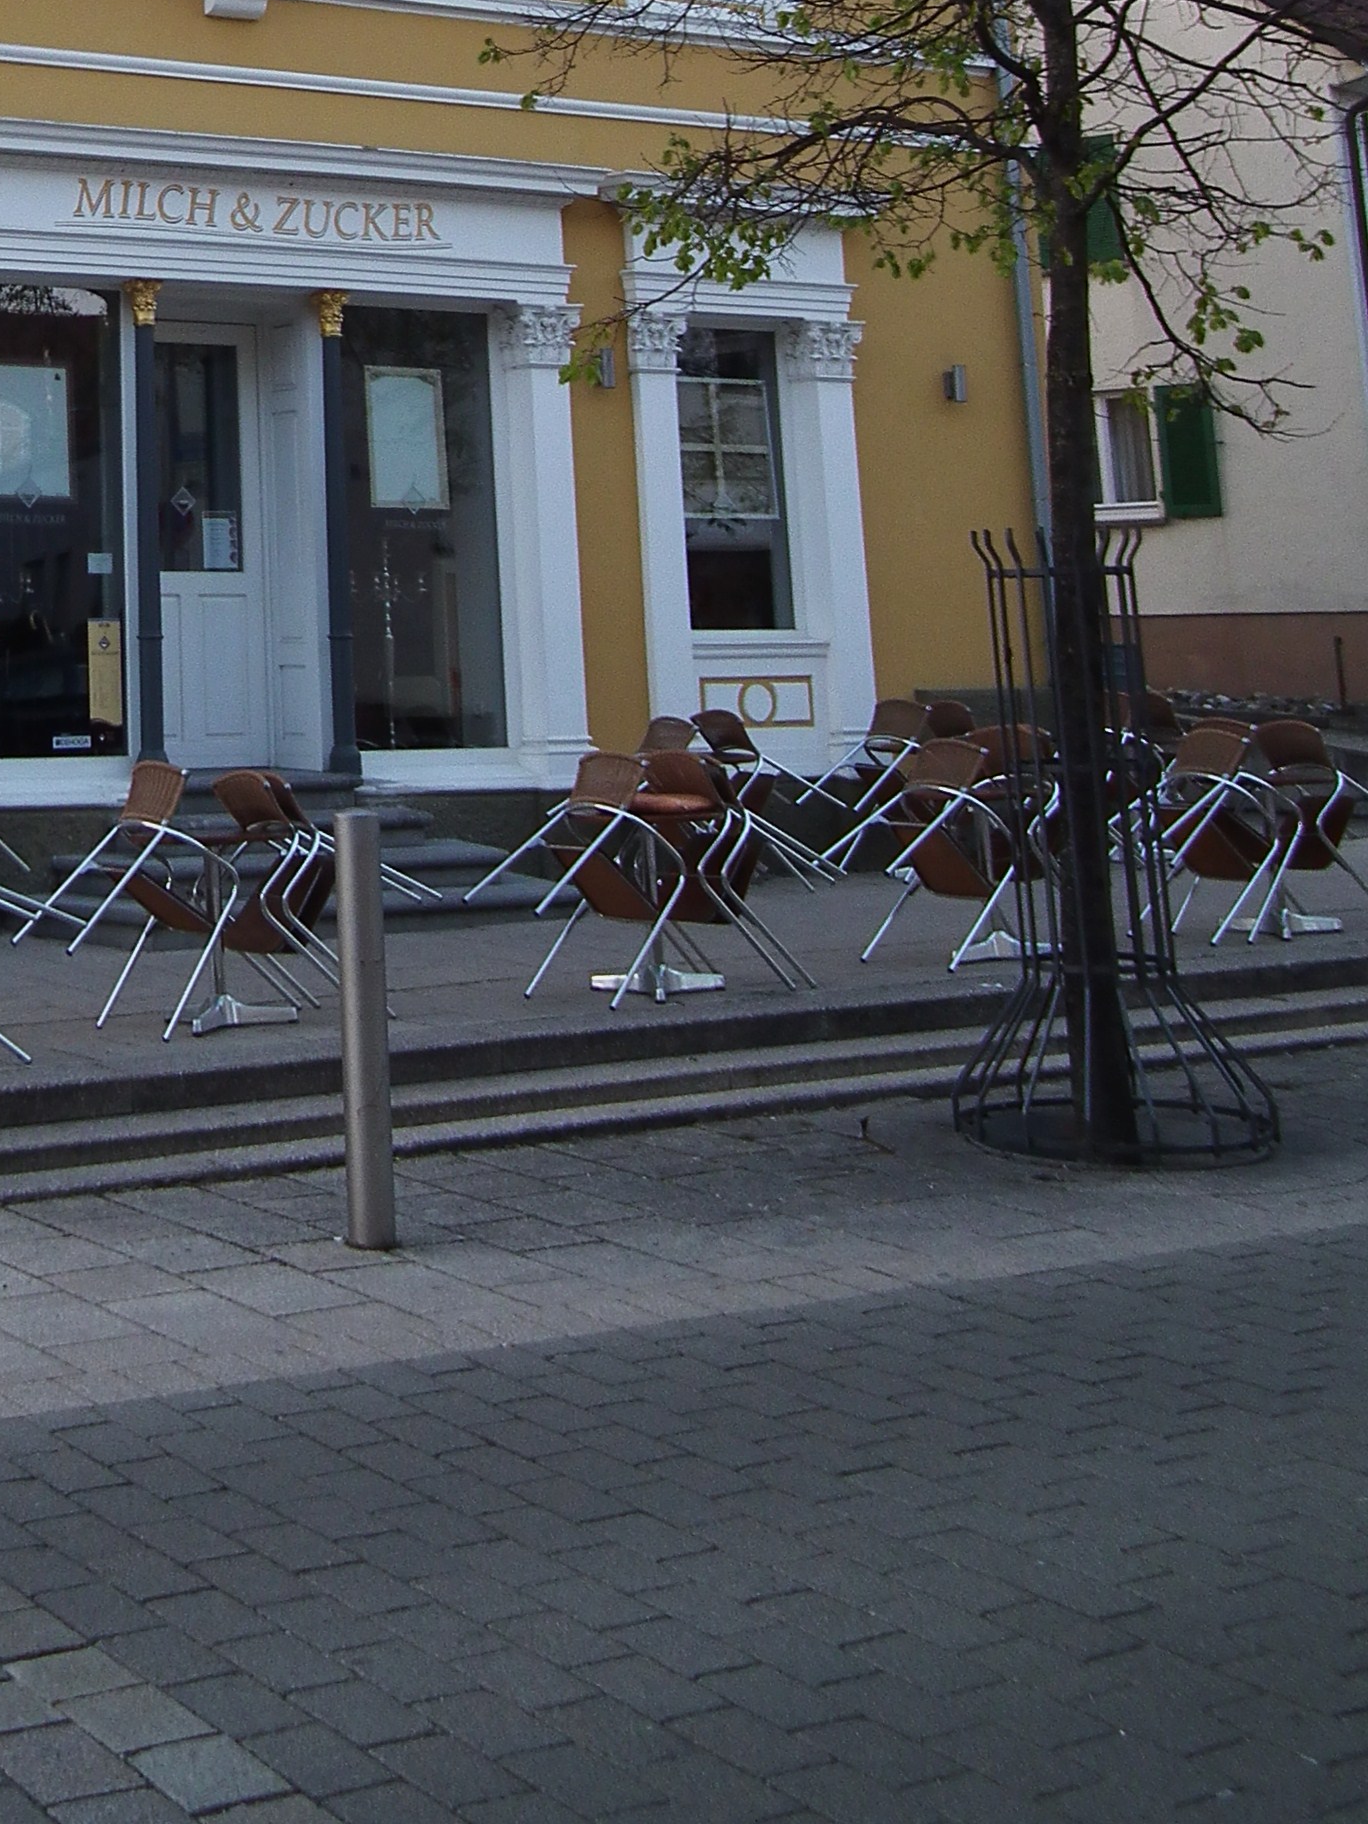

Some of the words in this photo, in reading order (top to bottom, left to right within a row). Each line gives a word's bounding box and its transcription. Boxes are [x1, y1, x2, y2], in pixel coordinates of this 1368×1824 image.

[73, 177, 220, 227] MILCH
[230, 192, 263, 233] &
[273, 196, 442, 242] ZUCKER
